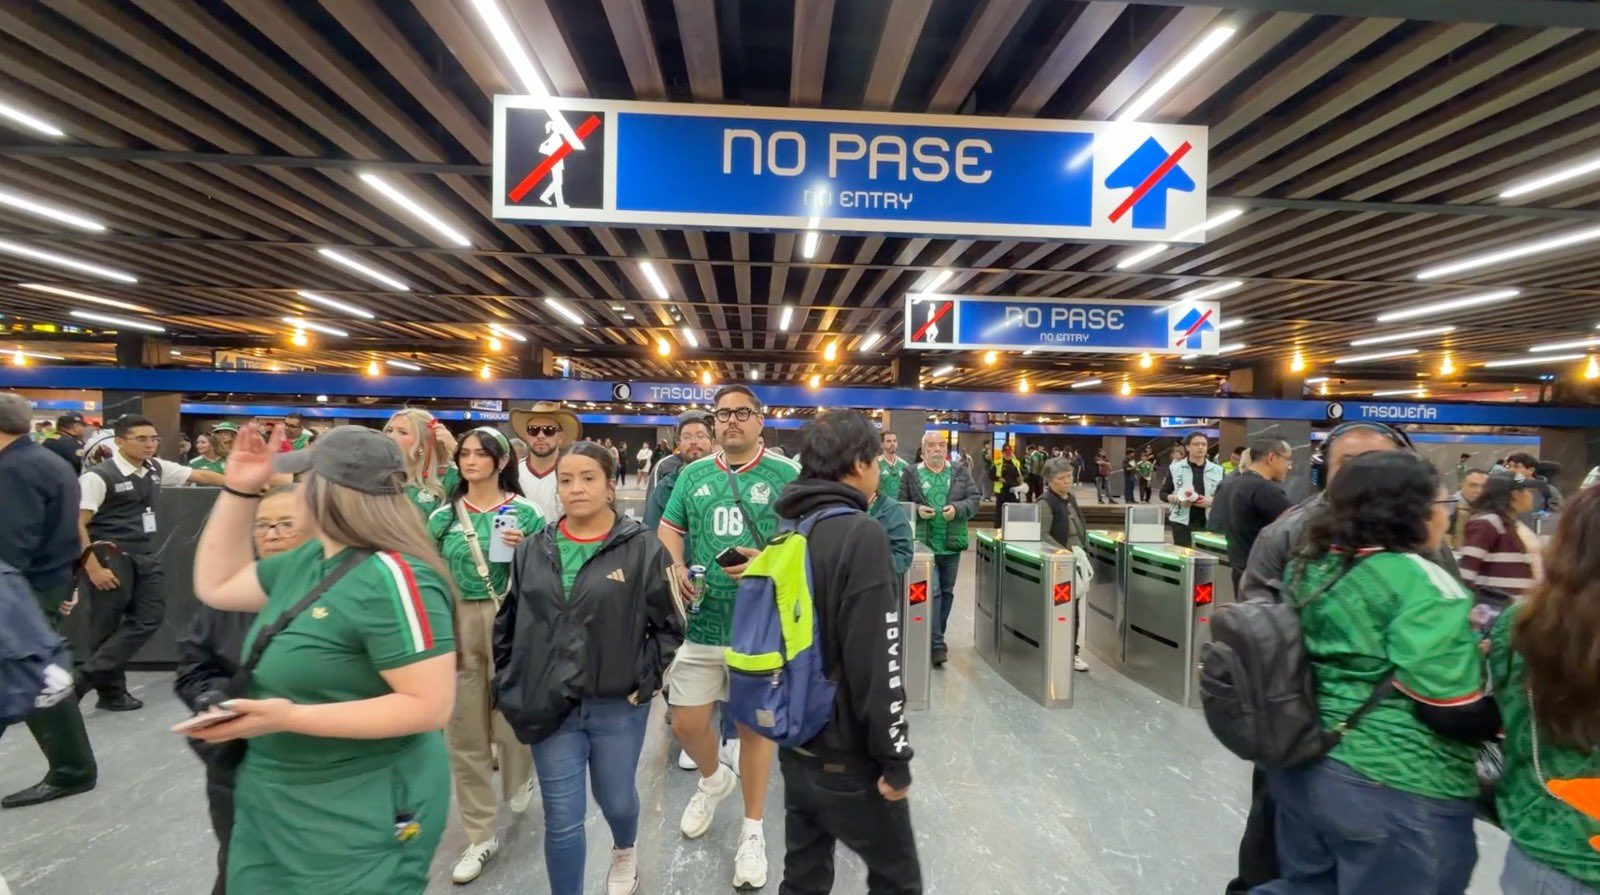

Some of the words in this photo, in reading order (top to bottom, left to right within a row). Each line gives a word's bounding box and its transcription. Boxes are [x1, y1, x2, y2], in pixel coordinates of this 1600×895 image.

[723, 128, 807, 177] NO
[829, 133, 993, 184] PASE
[840, 191, 913, 210] ENTRY
[1005, 306, 1042, 329] NO
[1051, 308, 1124, 330] PASE
[1040, 332, 1054, 341] NO
[1056, 333, 1090, 343] ENTRY
[480, 411, 509, 420] TASQUE
[1360, 404, 1437, 419] TASQUEÑA
[713, 506, 744, 537] 08
